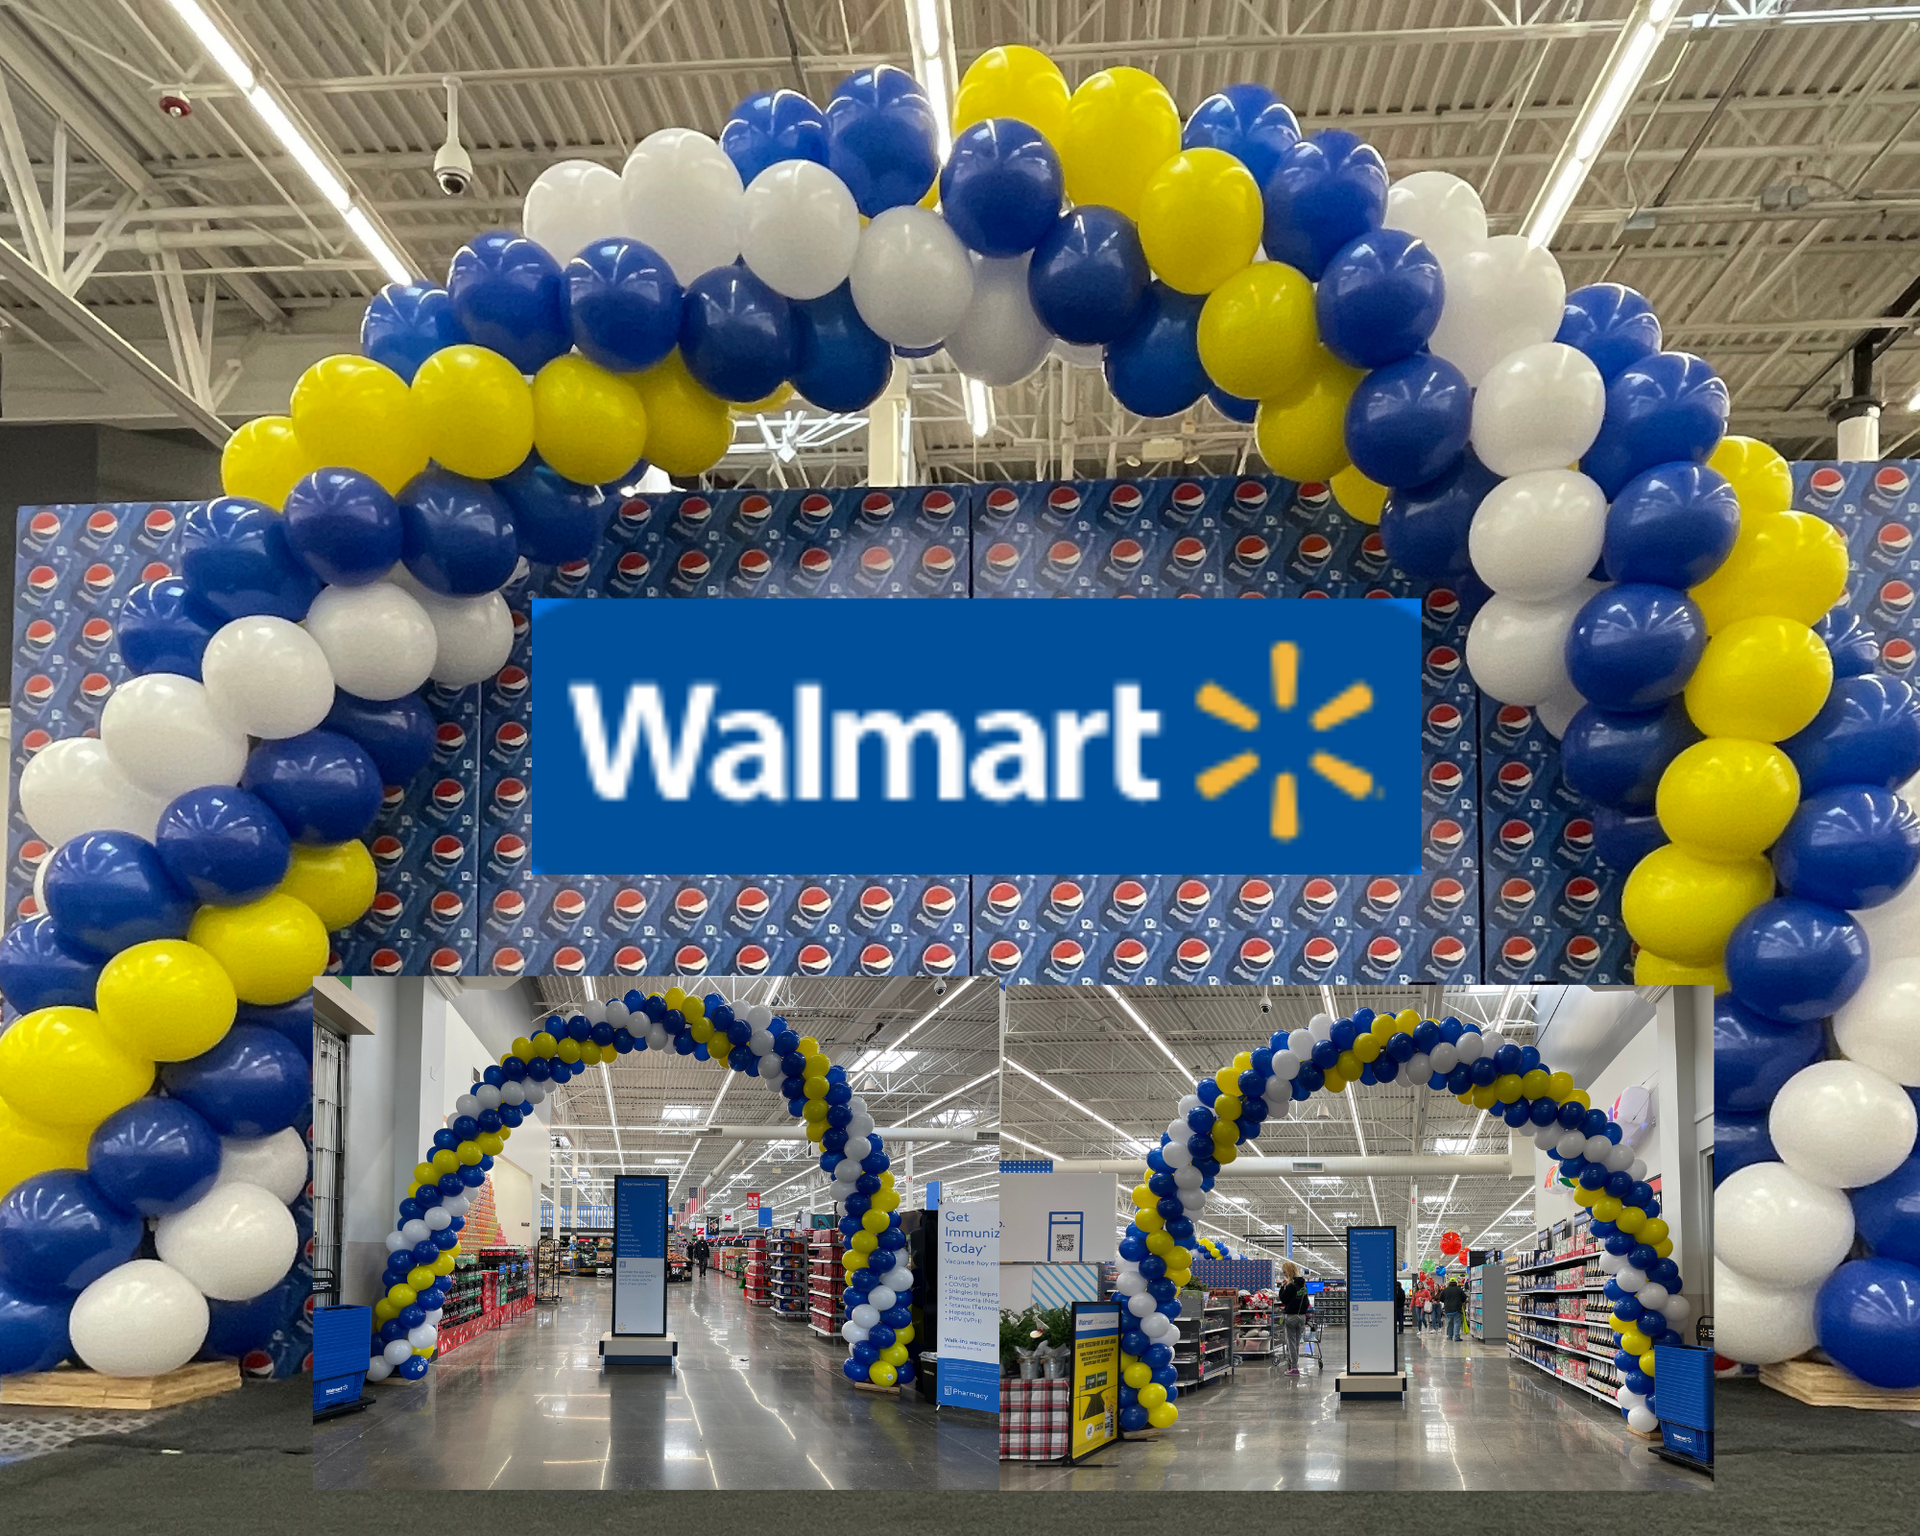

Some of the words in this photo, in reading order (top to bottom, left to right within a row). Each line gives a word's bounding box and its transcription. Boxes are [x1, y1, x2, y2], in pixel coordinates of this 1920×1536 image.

[945, 1211, 970, 1222] Get
[945, 1226, 1000, 1239] Immuniz
[952, 1387, 989, 1401] Pharmacy
